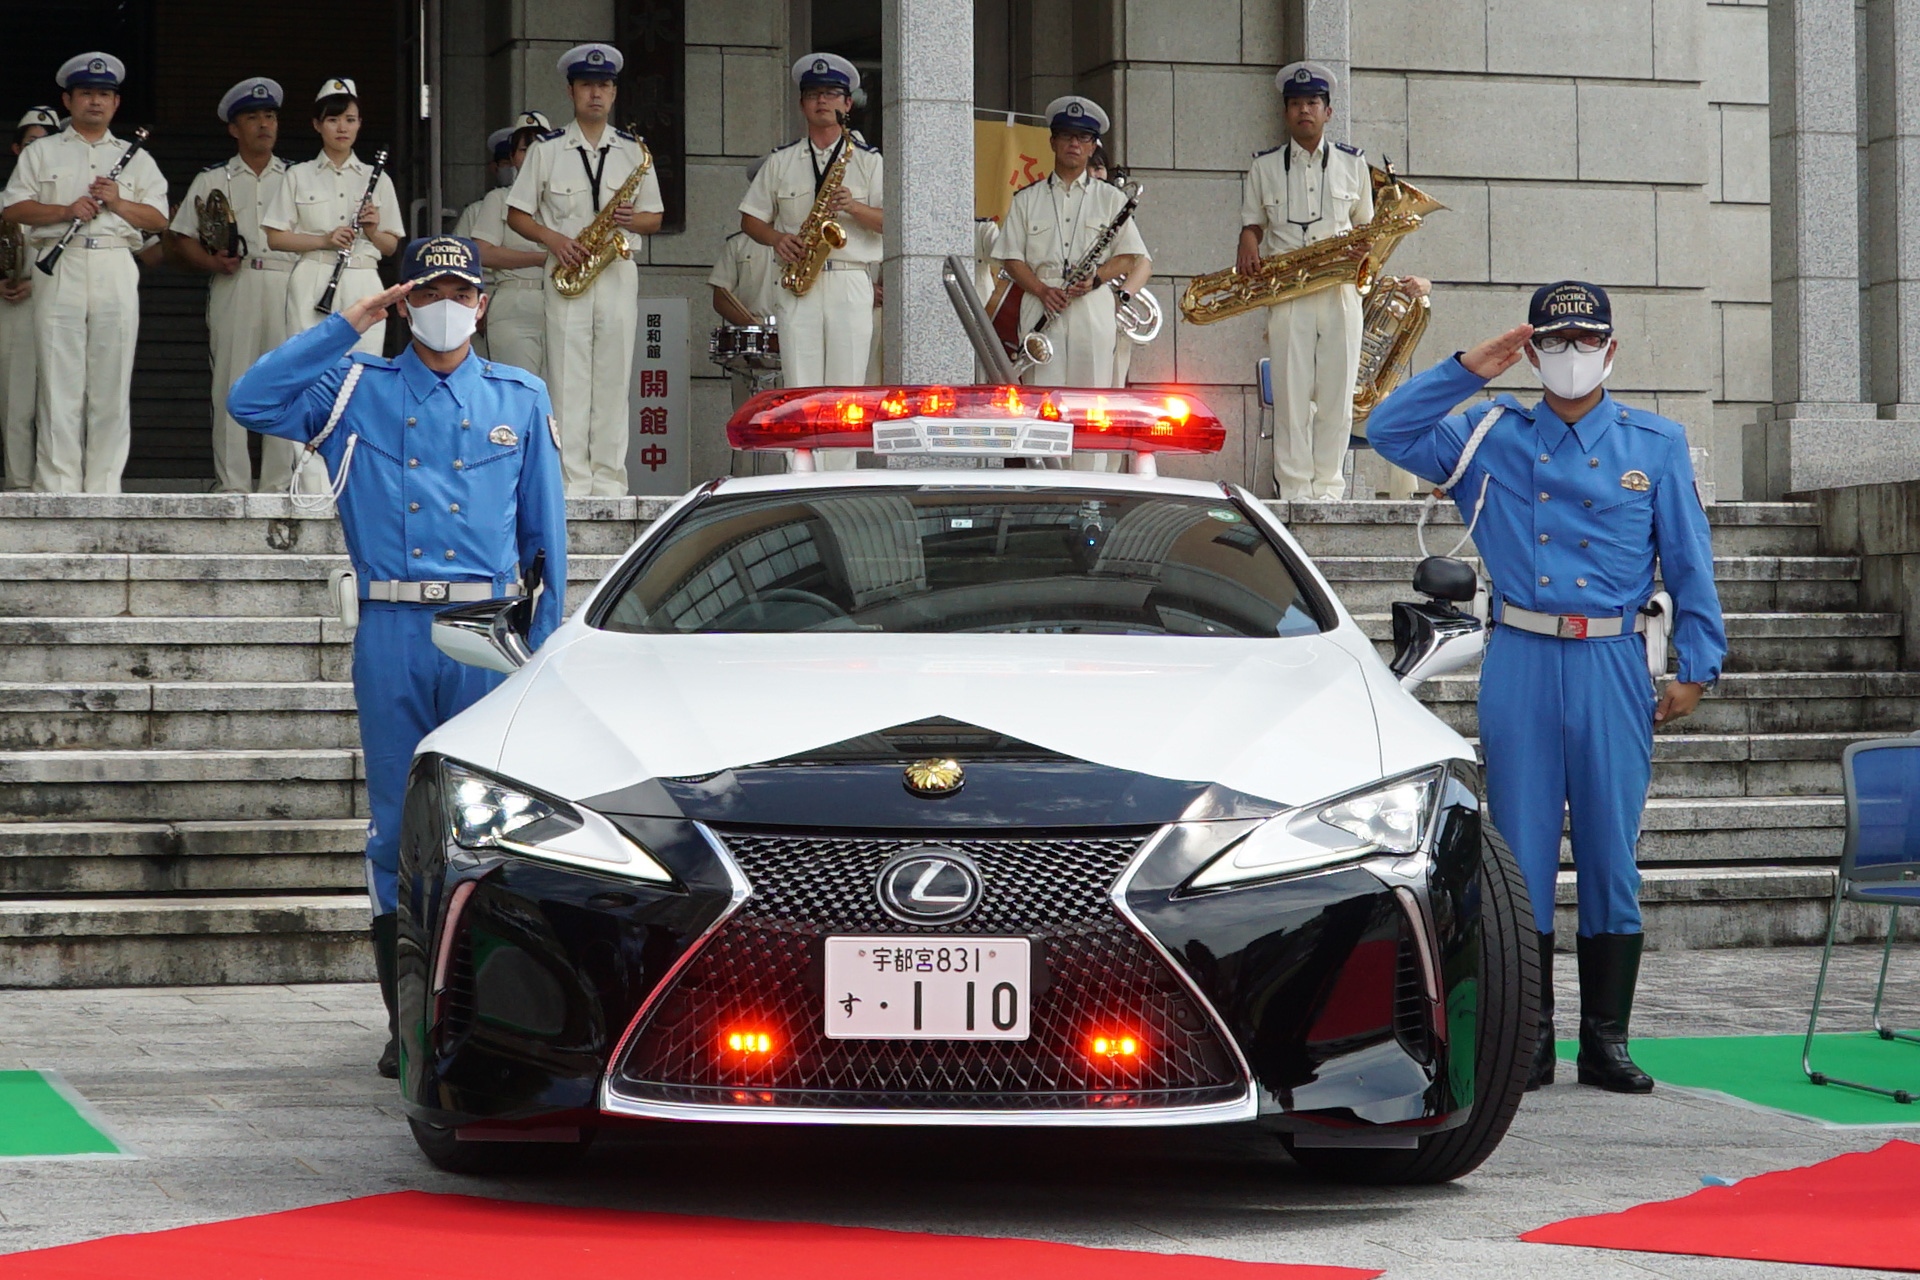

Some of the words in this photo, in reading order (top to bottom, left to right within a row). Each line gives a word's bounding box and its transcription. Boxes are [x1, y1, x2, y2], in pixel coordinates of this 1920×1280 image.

[425, 253, 468, 268] POLICE
[1550, 301, 1594, 316] POLICE
[647, 314, 661, 359] 昭和館
[640, 370, 668, 472] 開館中
